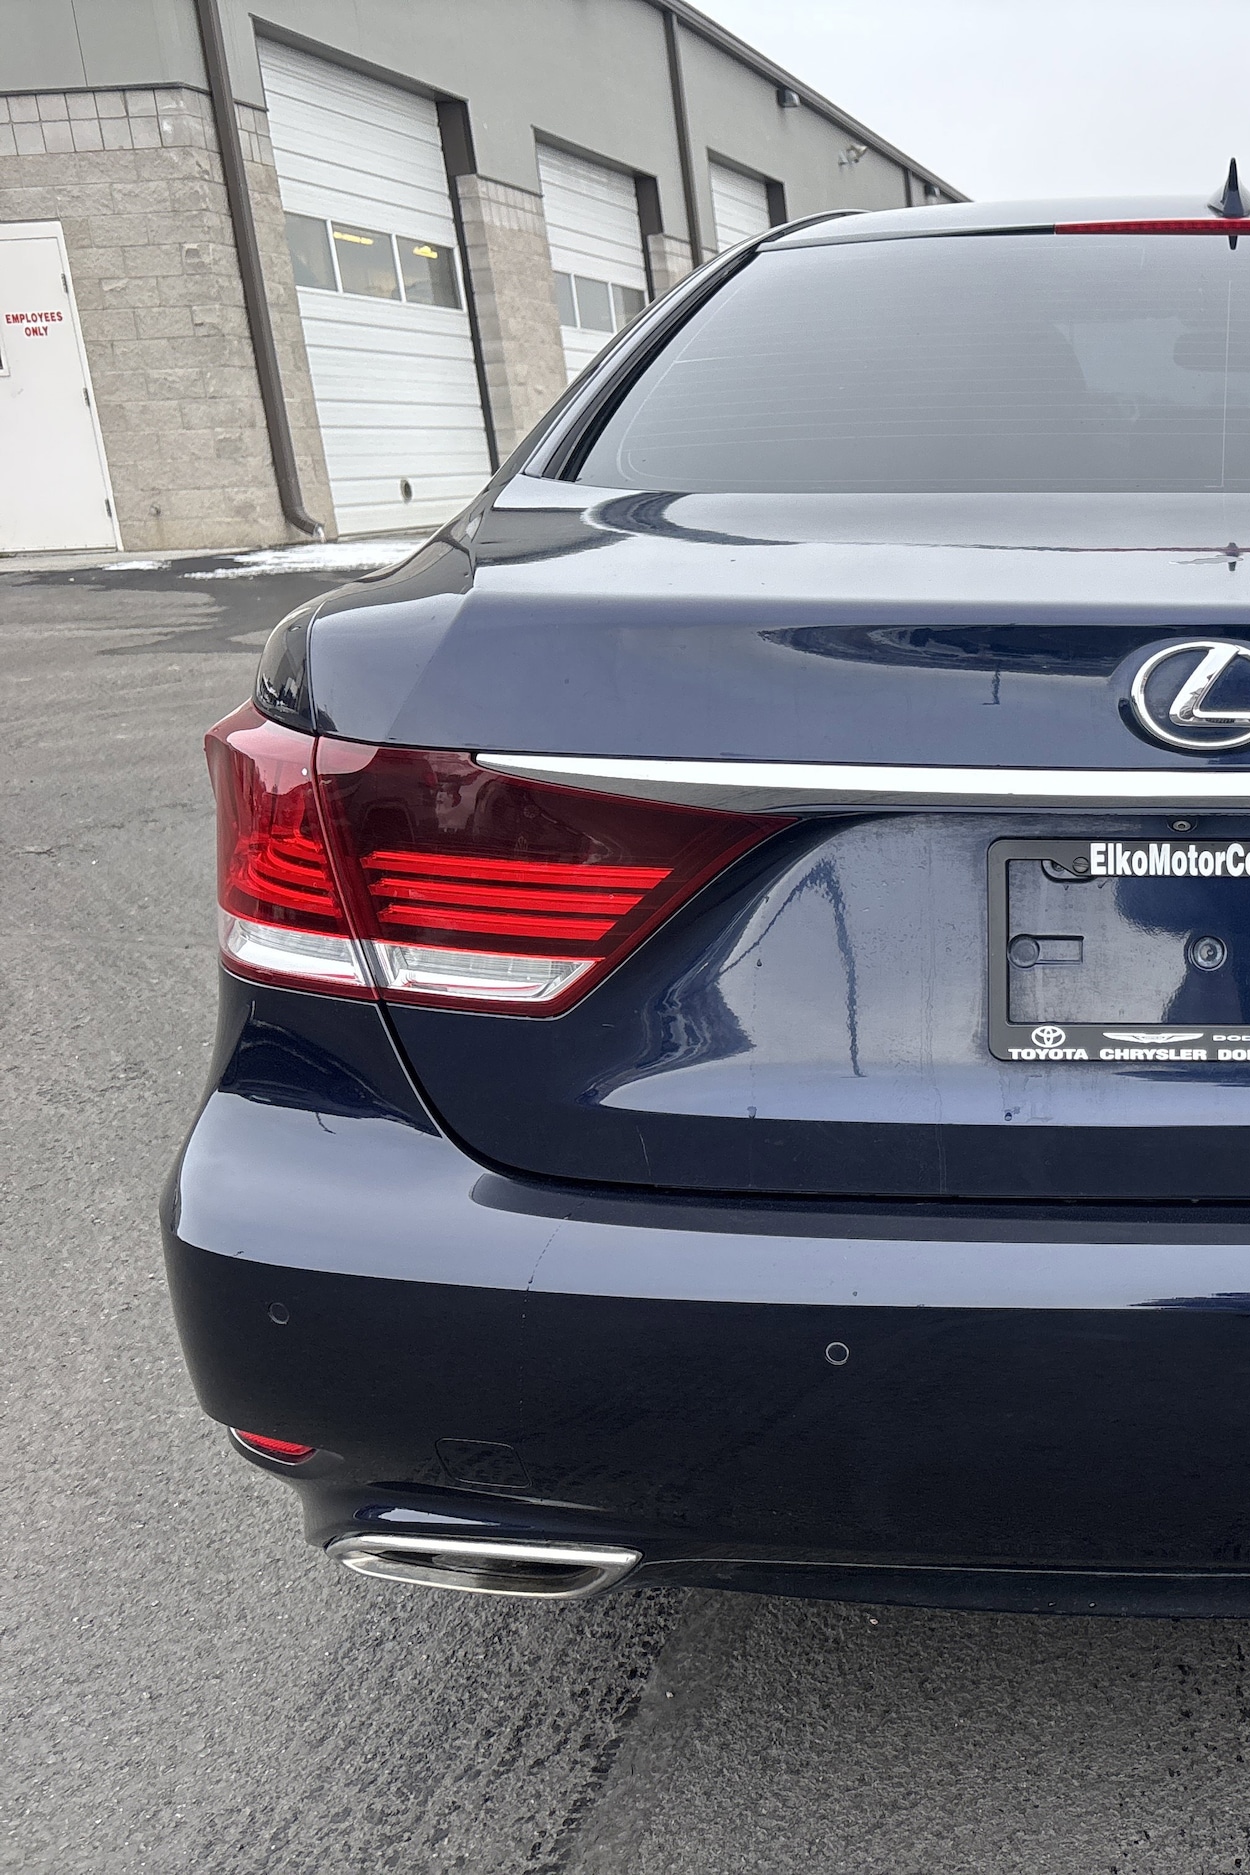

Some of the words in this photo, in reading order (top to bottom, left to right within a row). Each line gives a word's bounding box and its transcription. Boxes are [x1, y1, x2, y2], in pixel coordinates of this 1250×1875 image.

[5, 311, 63, 324] EMPLOYEES
[24, 326, 48, 337] ONLY
[1008, 1048, 1089, 1060] TOYOTA
[1100, 1048, 1207, 1060] CHRYSLER
